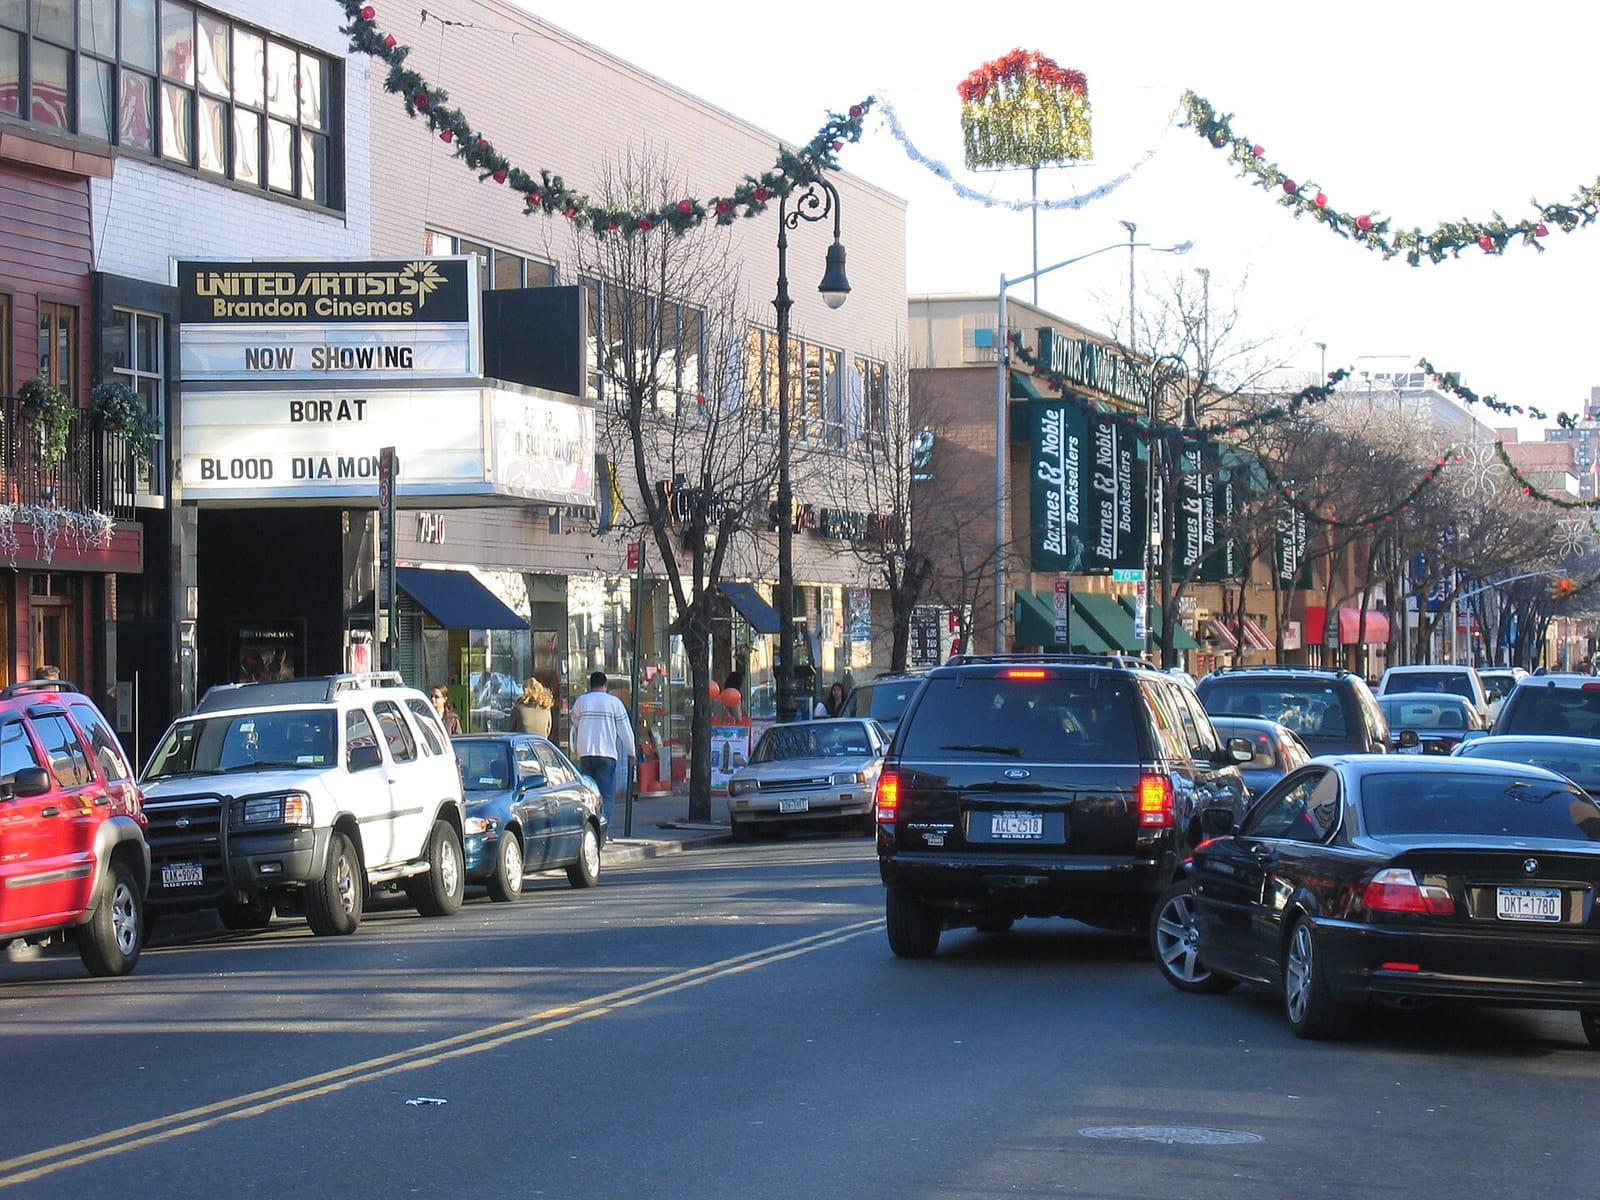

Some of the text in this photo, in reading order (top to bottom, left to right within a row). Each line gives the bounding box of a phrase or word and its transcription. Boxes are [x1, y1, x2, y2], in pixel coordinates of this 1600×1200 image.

[196, 271, 420, 296] UNITED ARTISTS
[213, 298, 413, 317] Brandon Cinemas
[245, 345, 413, 370] NOW SHOWING
[289, 399, 367, 422] BORAT
[200, 458, 274, 480] BLOOD
[1038, 408, 1062, 555] Barnes & Noble
[1066, 435, 1079, 526] Booksellers
[1093, 424, 1115, 560] Barnes & Noble
[1119, 450, 1131, 533] Booksellers
[1117, 570, 1131, 580] 70
